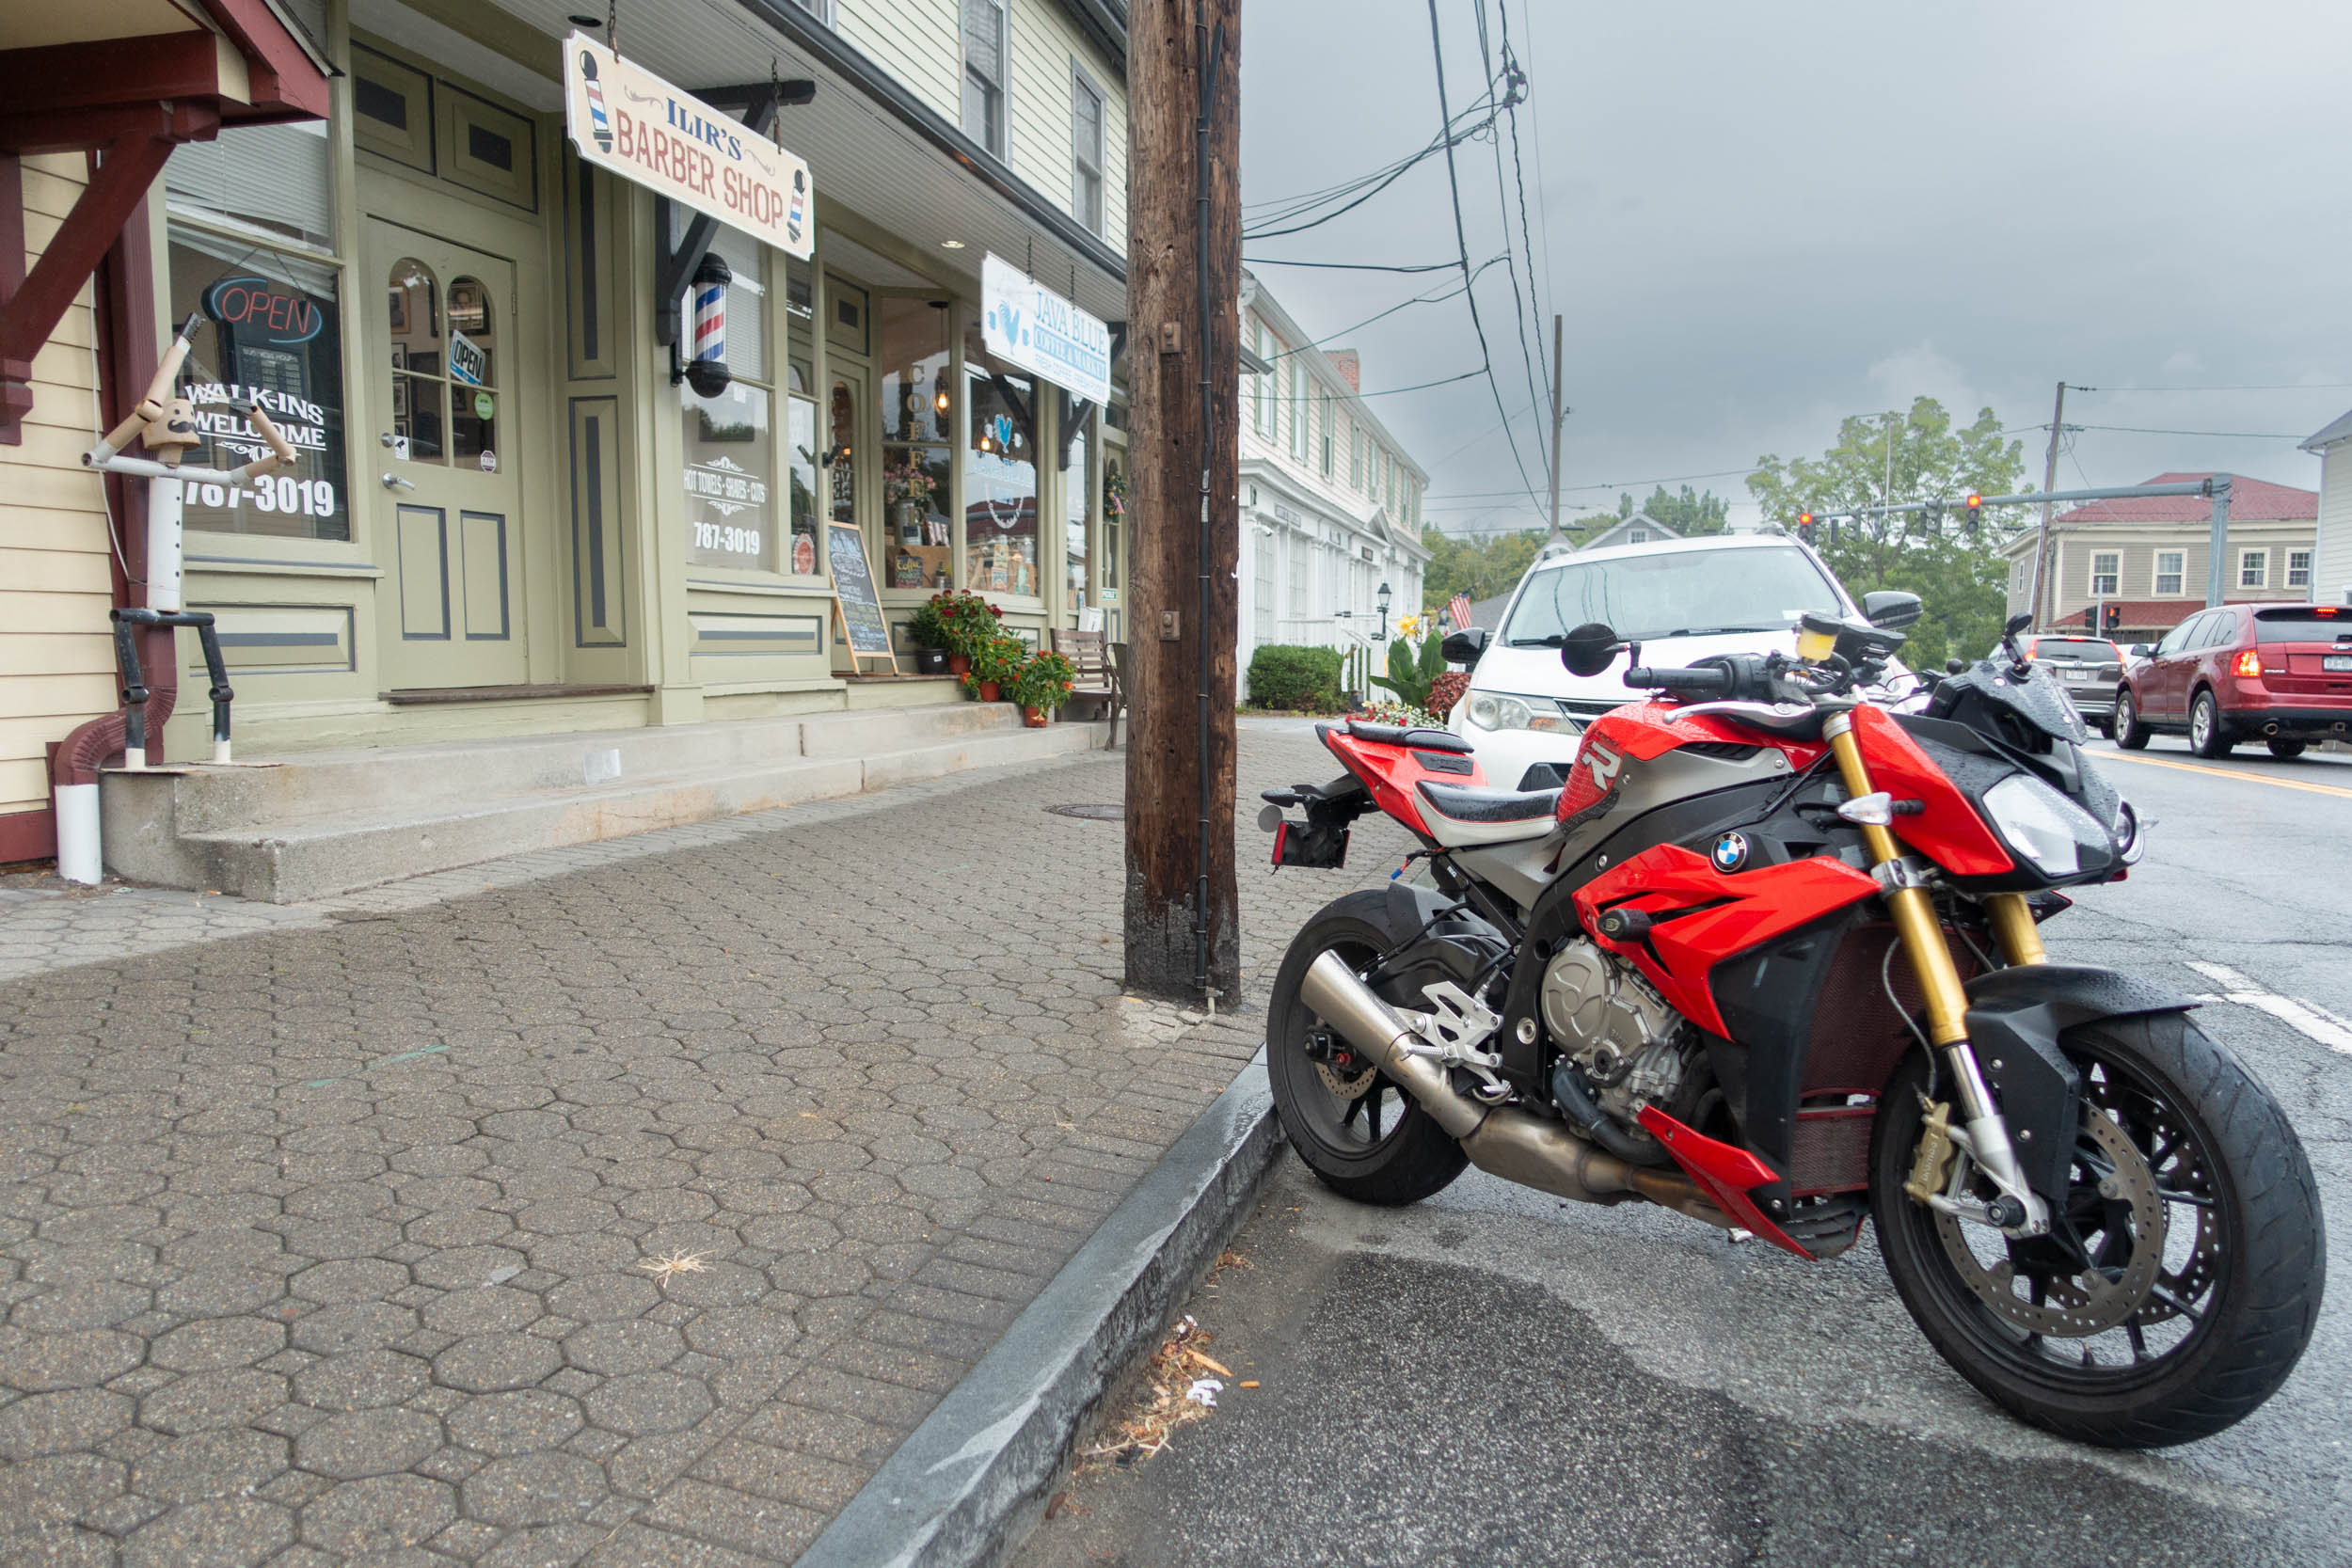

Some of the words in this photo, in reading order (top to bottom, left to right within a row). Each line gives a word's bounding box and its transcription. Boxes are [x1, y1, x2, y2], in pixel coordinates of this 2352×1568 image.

[666, 97, 742, 161] ILIR'S
[616, 108, 716, 200] BARBER
[723, 166, 784, 229] SHOP
[222, 288, 312, 333] OPEN
[1036, 291, 1069, 338] JAVA
[1072, 312, 1106, 356] BLUE
[453, 339, 483, 379] OPEN
[906, 364, 926, 525] COFFEE
[684, 468, 697, 491] HOT
[698, 471, 723, 496] TOWELS
[725, 476, 747, 499] SHAVES
[750, 482, 765, 504] CUTS
[693, 521, 760, 556] 787-3019
[1581, 740, 1621, 791] R
